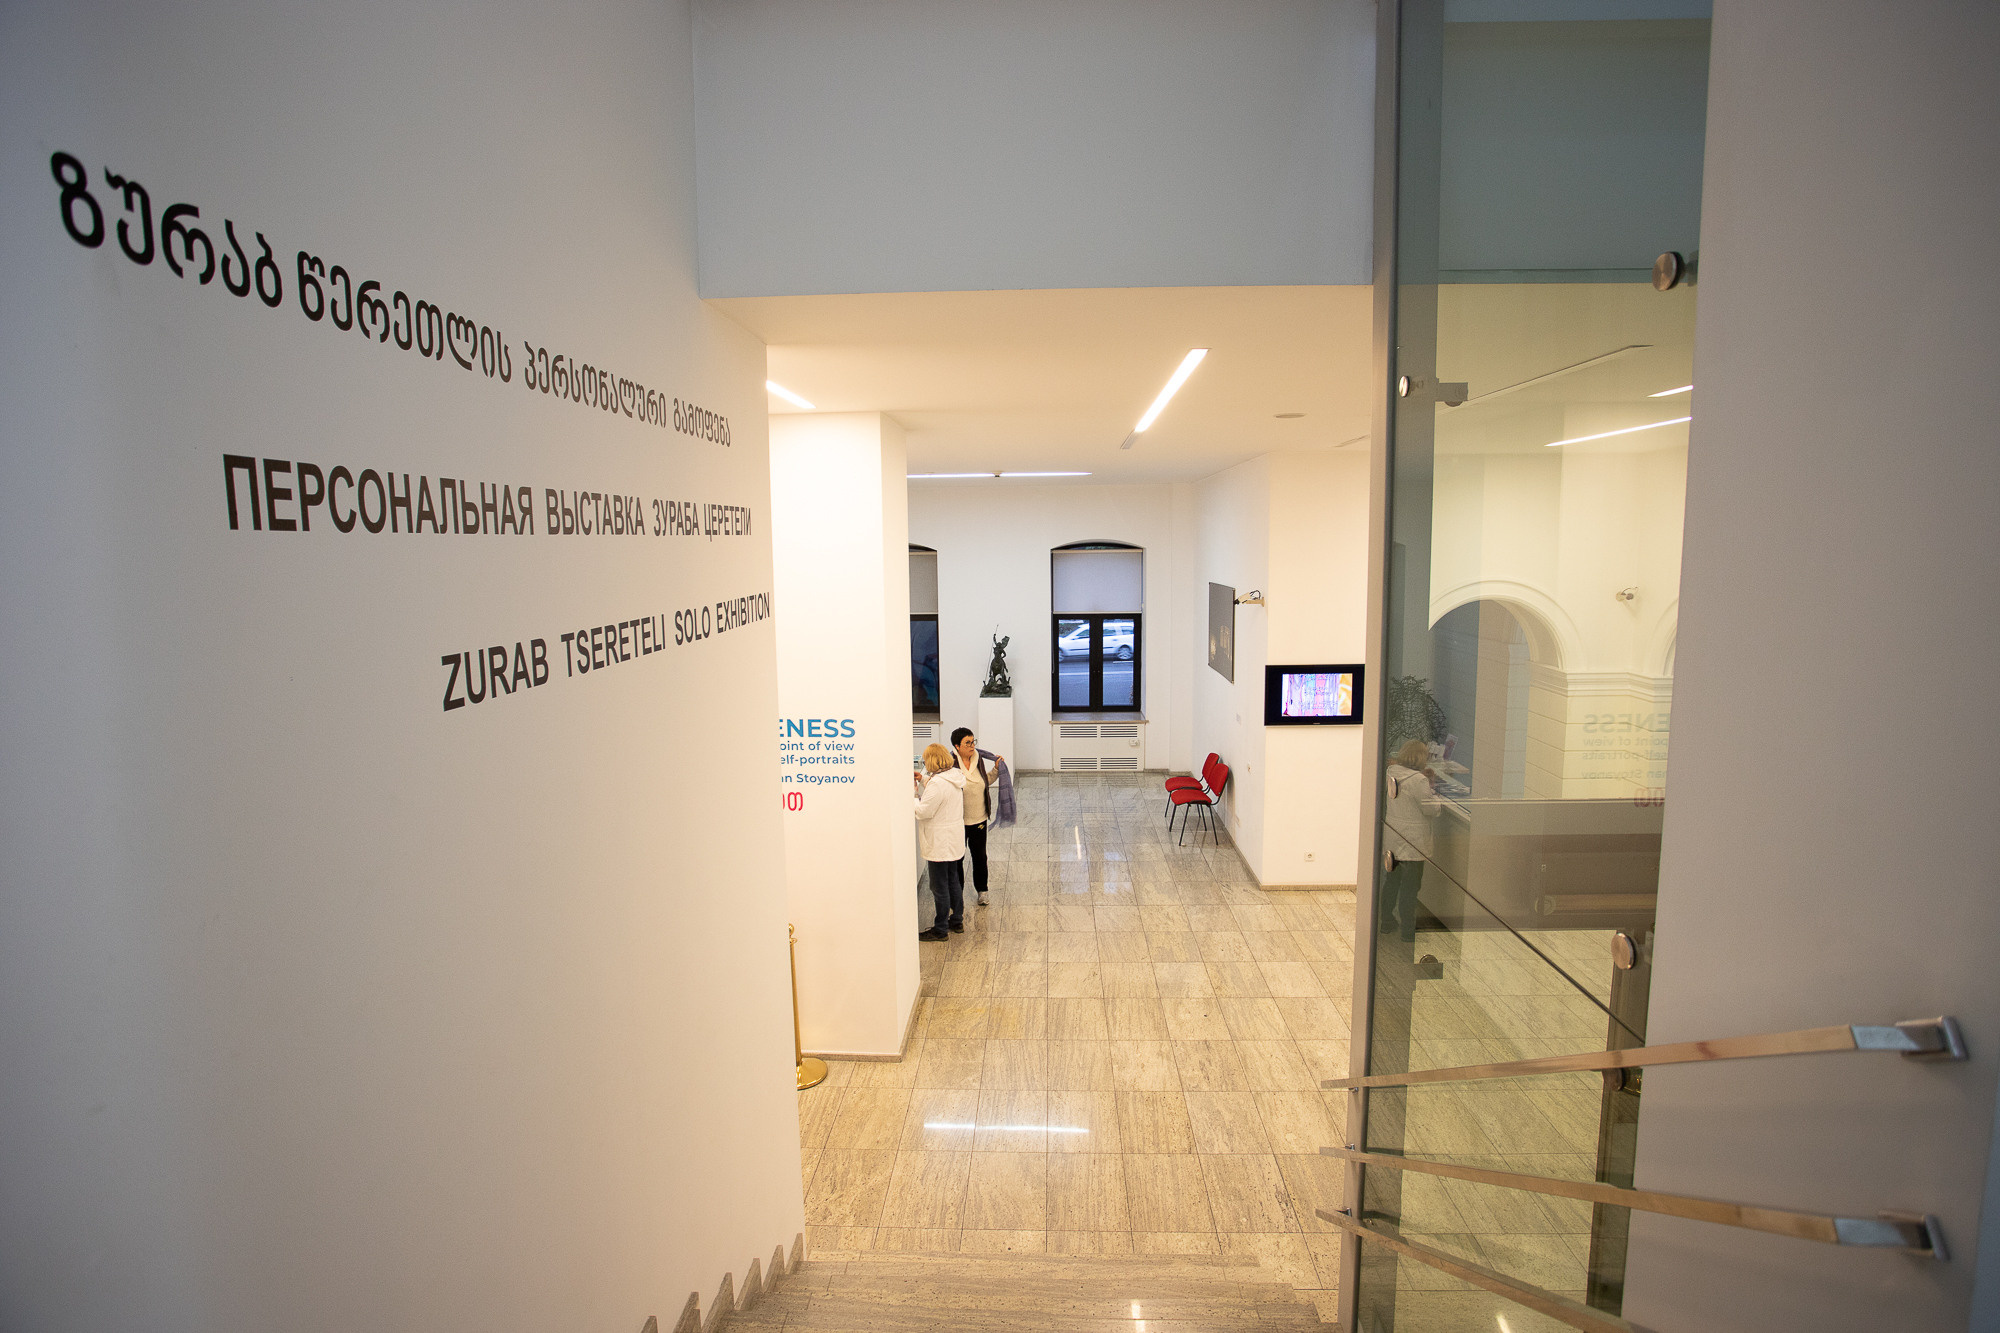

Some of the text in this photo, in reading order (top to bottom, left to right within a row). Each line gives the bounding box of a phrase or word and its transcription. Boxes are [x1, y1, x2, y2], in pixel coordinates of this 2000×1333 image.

[50, 150, 731, 448] ზურაბ წერეთლის პერსონალური გამოფენა
[223, 453, 753, 543] ПЕРСОНАЛЬНАЯ ВЫСТАВКА ЗУРАБА ЦЕРЕТЕЛИ
[440, 591, 771, 713] ZURAB TSERETELI SOLO EXHIBITION
[781, 773, 856, 785] n Stoyanov
[808, 741, 821, 751] of
[824, 741, 855, 751] view
